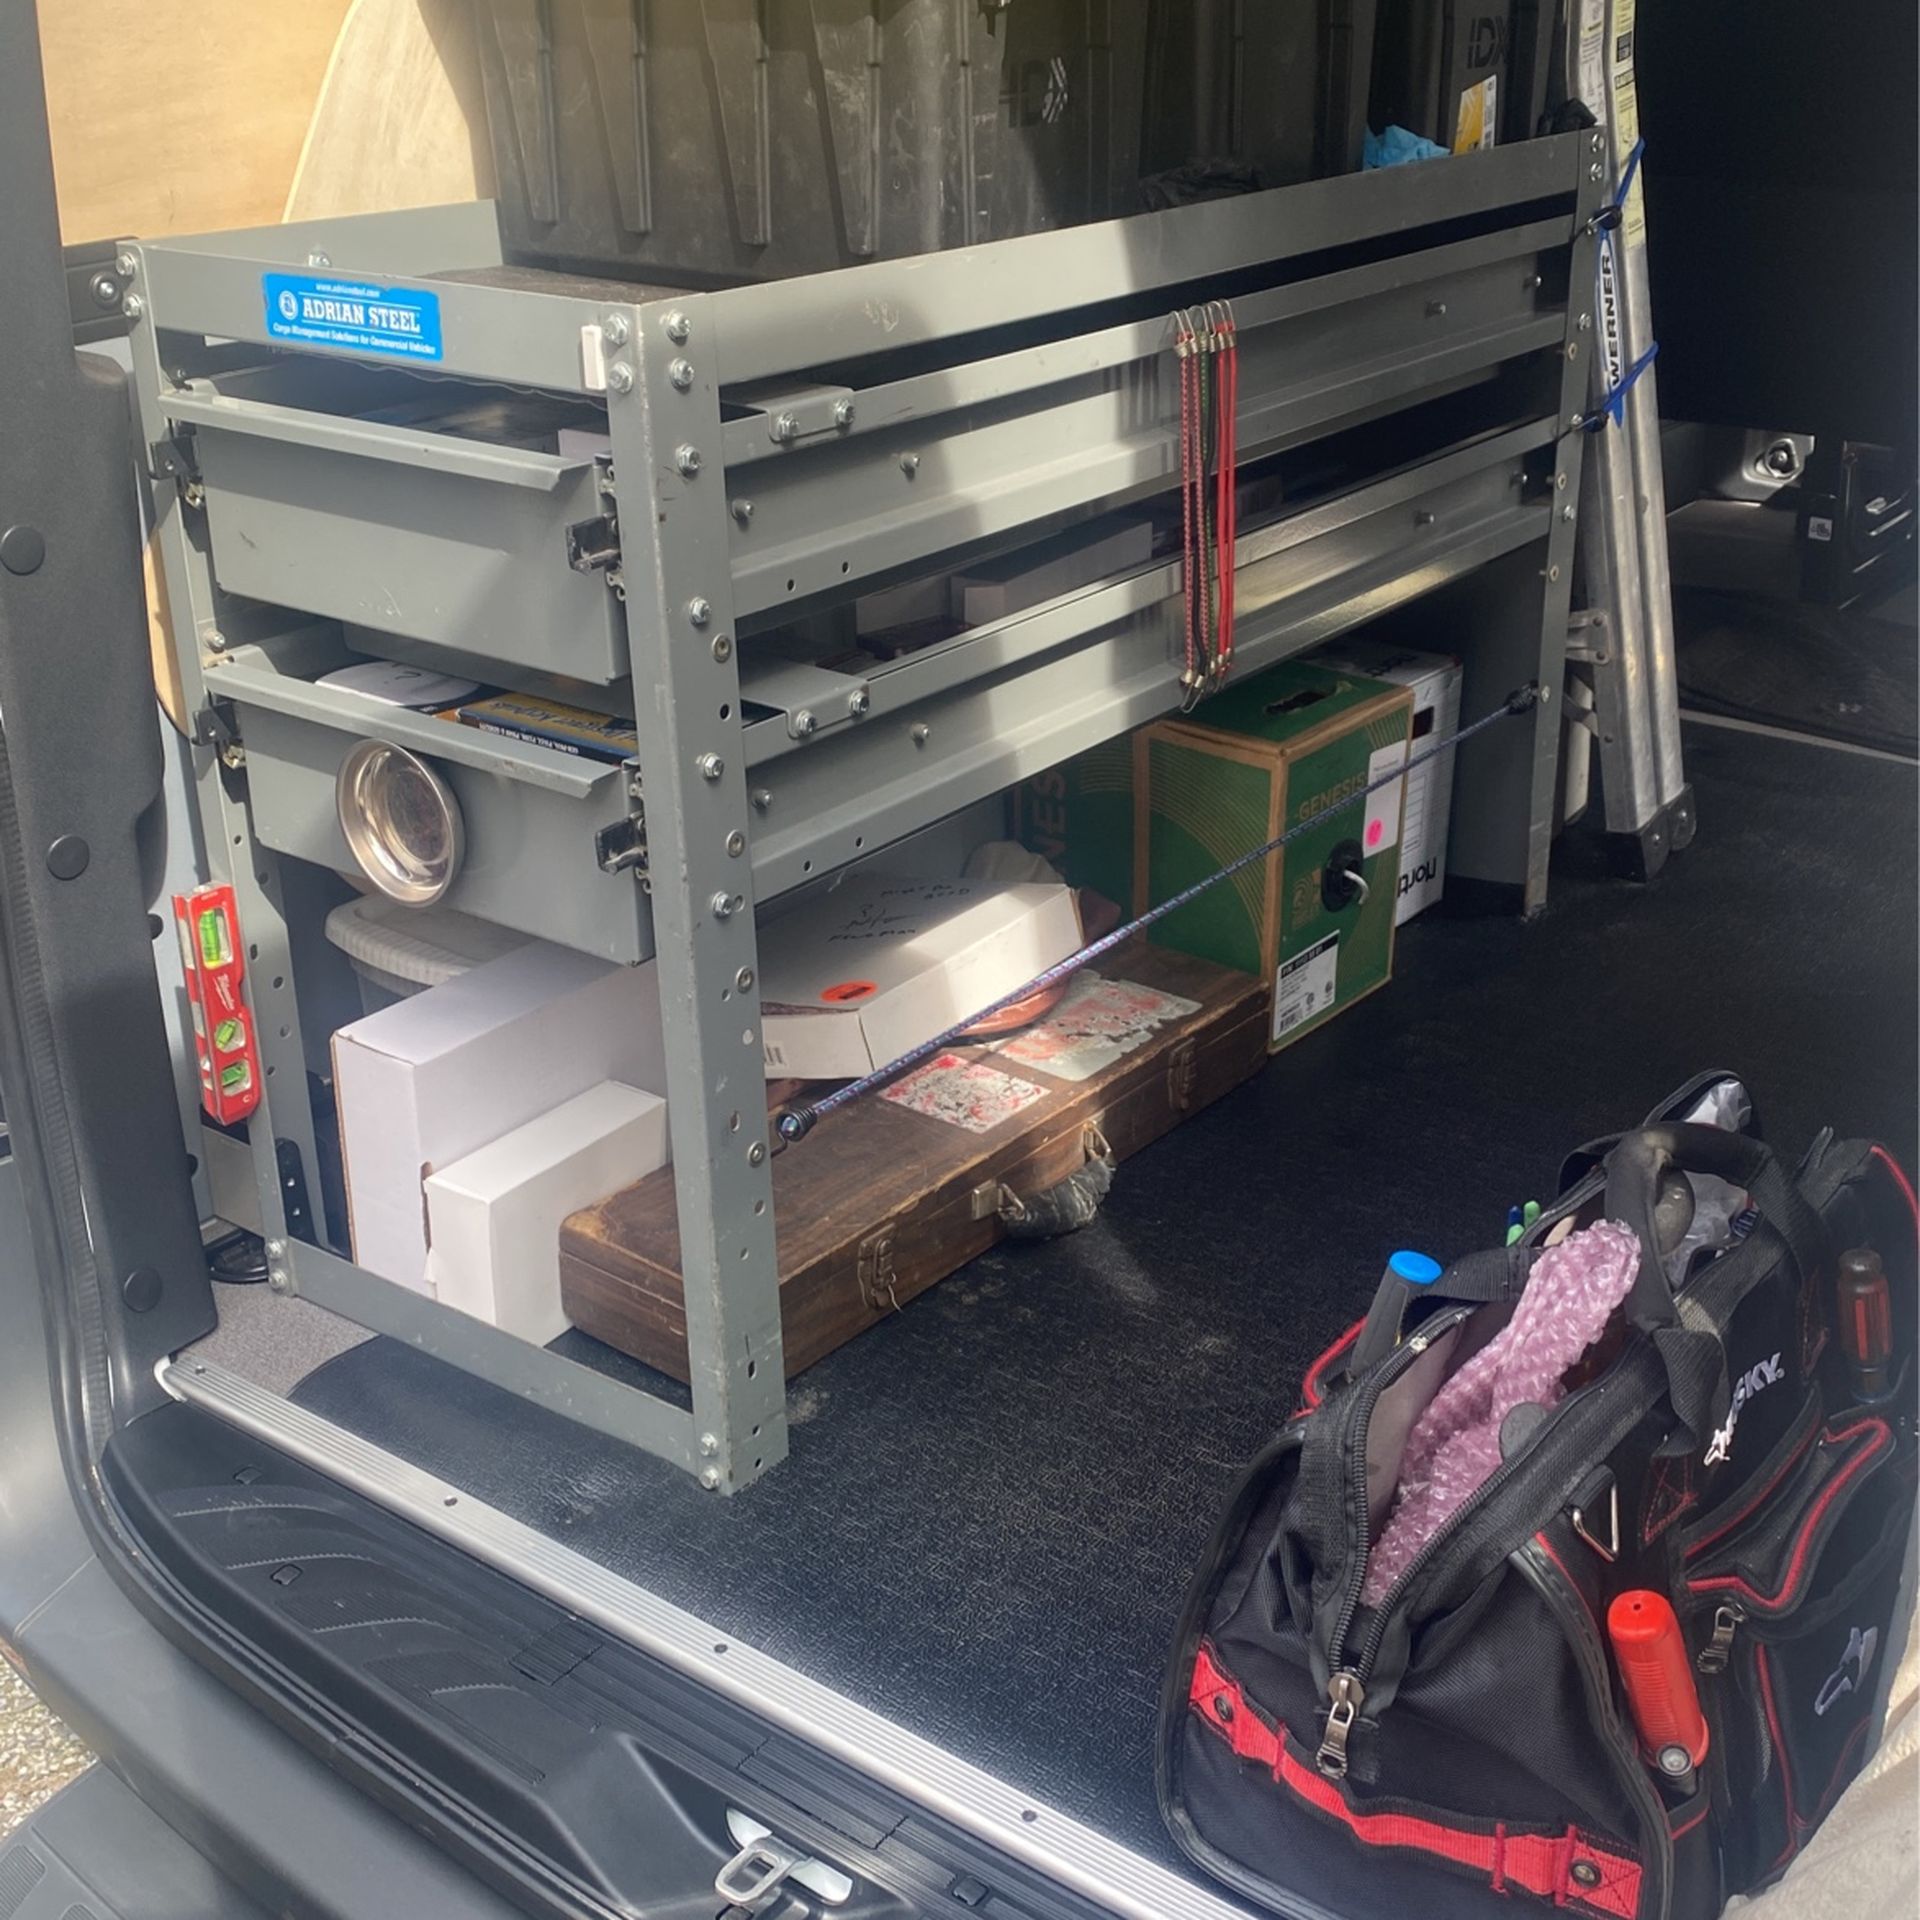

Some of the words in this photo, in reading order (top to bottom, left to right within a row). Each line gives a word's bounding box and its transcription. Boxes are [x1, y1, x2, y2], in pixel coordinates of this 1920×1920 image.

[302, 298, 365, 325] ADRIAN
[367, 305, 421, 333] STEEL
[1602, 254, 1620, 386] WERNER
